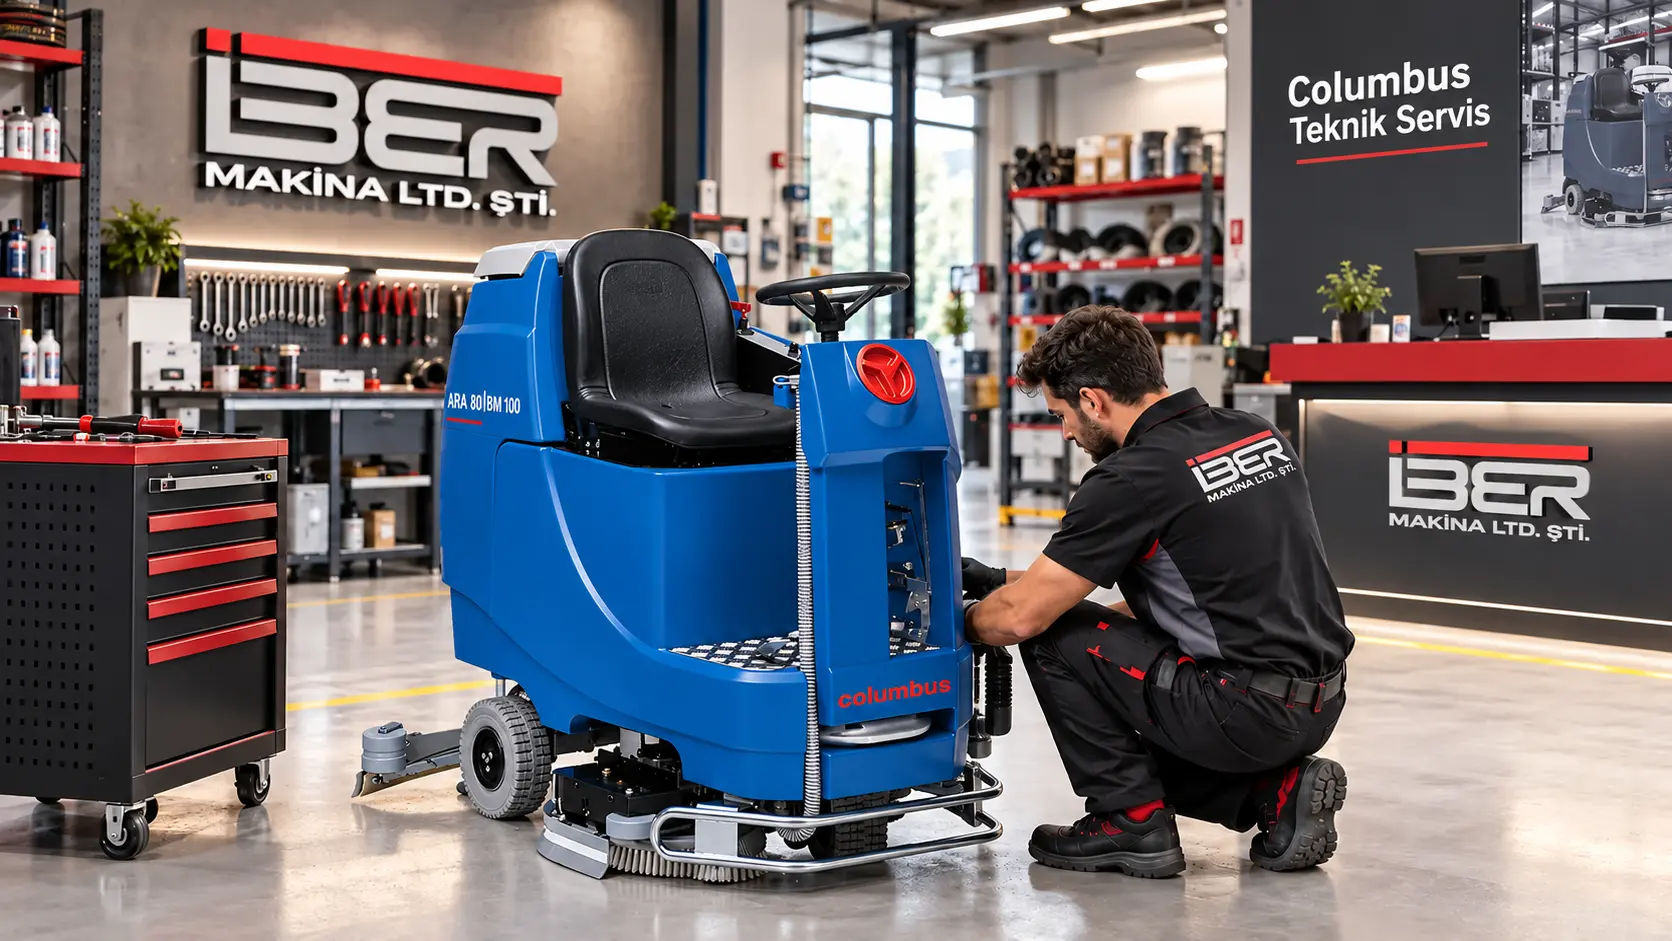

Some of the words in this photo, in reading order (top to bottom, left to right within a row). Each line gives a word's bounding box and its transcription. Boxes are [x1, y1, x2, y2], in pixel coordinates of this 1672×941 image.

[1288, 61, 1471, 108] Columbus
[1289, 107, 1388, 144] Teknik
[1395, 97, 1491, 134] Servis
[205, 160, 389, 203] MAKİNA
[398, 180, 481, 211] LTD.
[489, 189, 557, 217] ŞTİ.
[447, 392, 468, 410] ARA
[503, 396, 521, 414] 100
[1206, 479, 1255, 503] MAKİNA
[1254, 469, 1278, 485] LTD.
[1389, 512, 1486, 534] MAKİNA
[1492, 520, 1541, 538] LTD.
[1546, 523, 1591, 543] ŞTİ.
[837, 679, 952, 709] columbus
